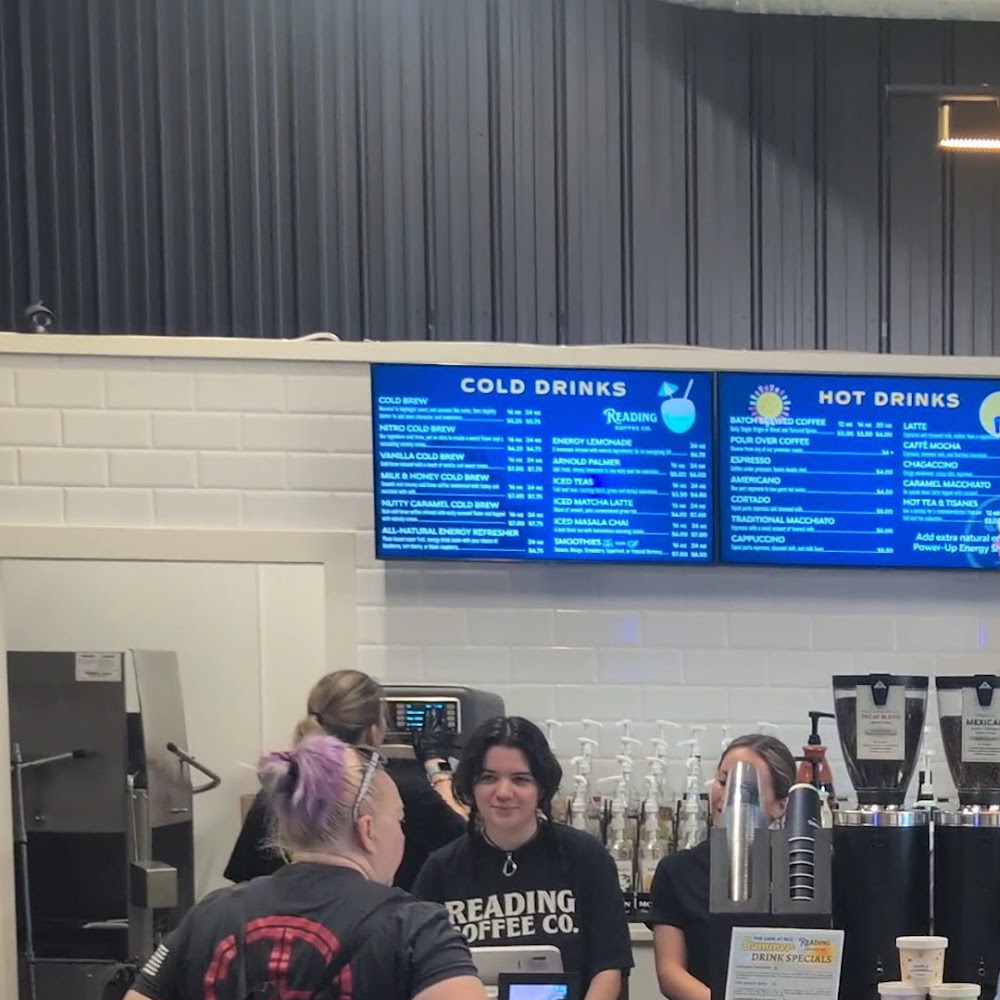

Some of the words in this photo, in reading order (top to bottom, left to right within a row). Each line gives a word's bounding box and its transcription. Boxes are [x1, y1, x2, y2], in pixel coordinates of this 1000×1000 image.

[460, 378, 525, 394] COLD
[535, 380, 627, 397] DRINKS
[819, 390, 865, 405] HOT
[874, 392, 960, 408] DRINKS
[603, 408, 658, 424] READING
[796, 418, 826, 426] COFFEE
[904, 422, 927, 430] LATTE
[379, 424, 405, 432] NITRO
[406, 425, 430, 433] COLD
[552, 437, 585, 446] ENERGY
[587, 438, 632, 447] LEMONADE
[730, 436, 754, 445] POUR
[755, 437, 777, 445] OVER
[779, 438, 810, 446] COFFEE
[929, 442, 961, 450] MOCHA
[380, 452, 415, 460] VANILLA
[440, 453, 465, 461] BREW
[730, 456, 771, 464] ESPRESSO
[588, 458, 621, 466] PALMER
[903, 461, 958, 469] CHAGACCINO
[381, 472, 400, 480] MILK
[731, 476, 781, 484] AMERICANO
[553, 478, 572, 486] ICED
[574, 478, 594, 486] TEAS
[903, 480, 942, 488] CARAMEL
[943, 480, 991, 489] MACCHIATO
[410, 500, 450, 508] CARAMEL
[451, 501, 473, 509] COLD
[554, 498, 573, 506] ICED
[574, 499, 609, 507] MATCHA
[610, 499, 634, 507] LATTE
[903, 499, 920, 507] HOT
[922, 499, 937, 507] TEA
[574, 518, 607, 526] MASALA
[731, 515, 785, 523] TRADITIONAL
[786, 517, 835, 525] MACCHIATO
[382, 527, 437, 535] ALL-NATURAL
[554, 538, 601, 546] SMOOTHIES
[731, 535, 785, 543] CAPPUCCINO
[916, 533, 934, 541] Add
[936, 534, 957, 542] extra
[960, 534, 990, 542] natural
[914, 543, 957, 553] Power-Up
[959, 544, 989, 554] Energy
[445, 889, 576, 925] READING
[452, 916, 536, 943] OFFEE
[542, 914, 579, 933] CO.
[752, 953, 784, 962] DRINK
[786, 954, 832, 963] SPECIALS
